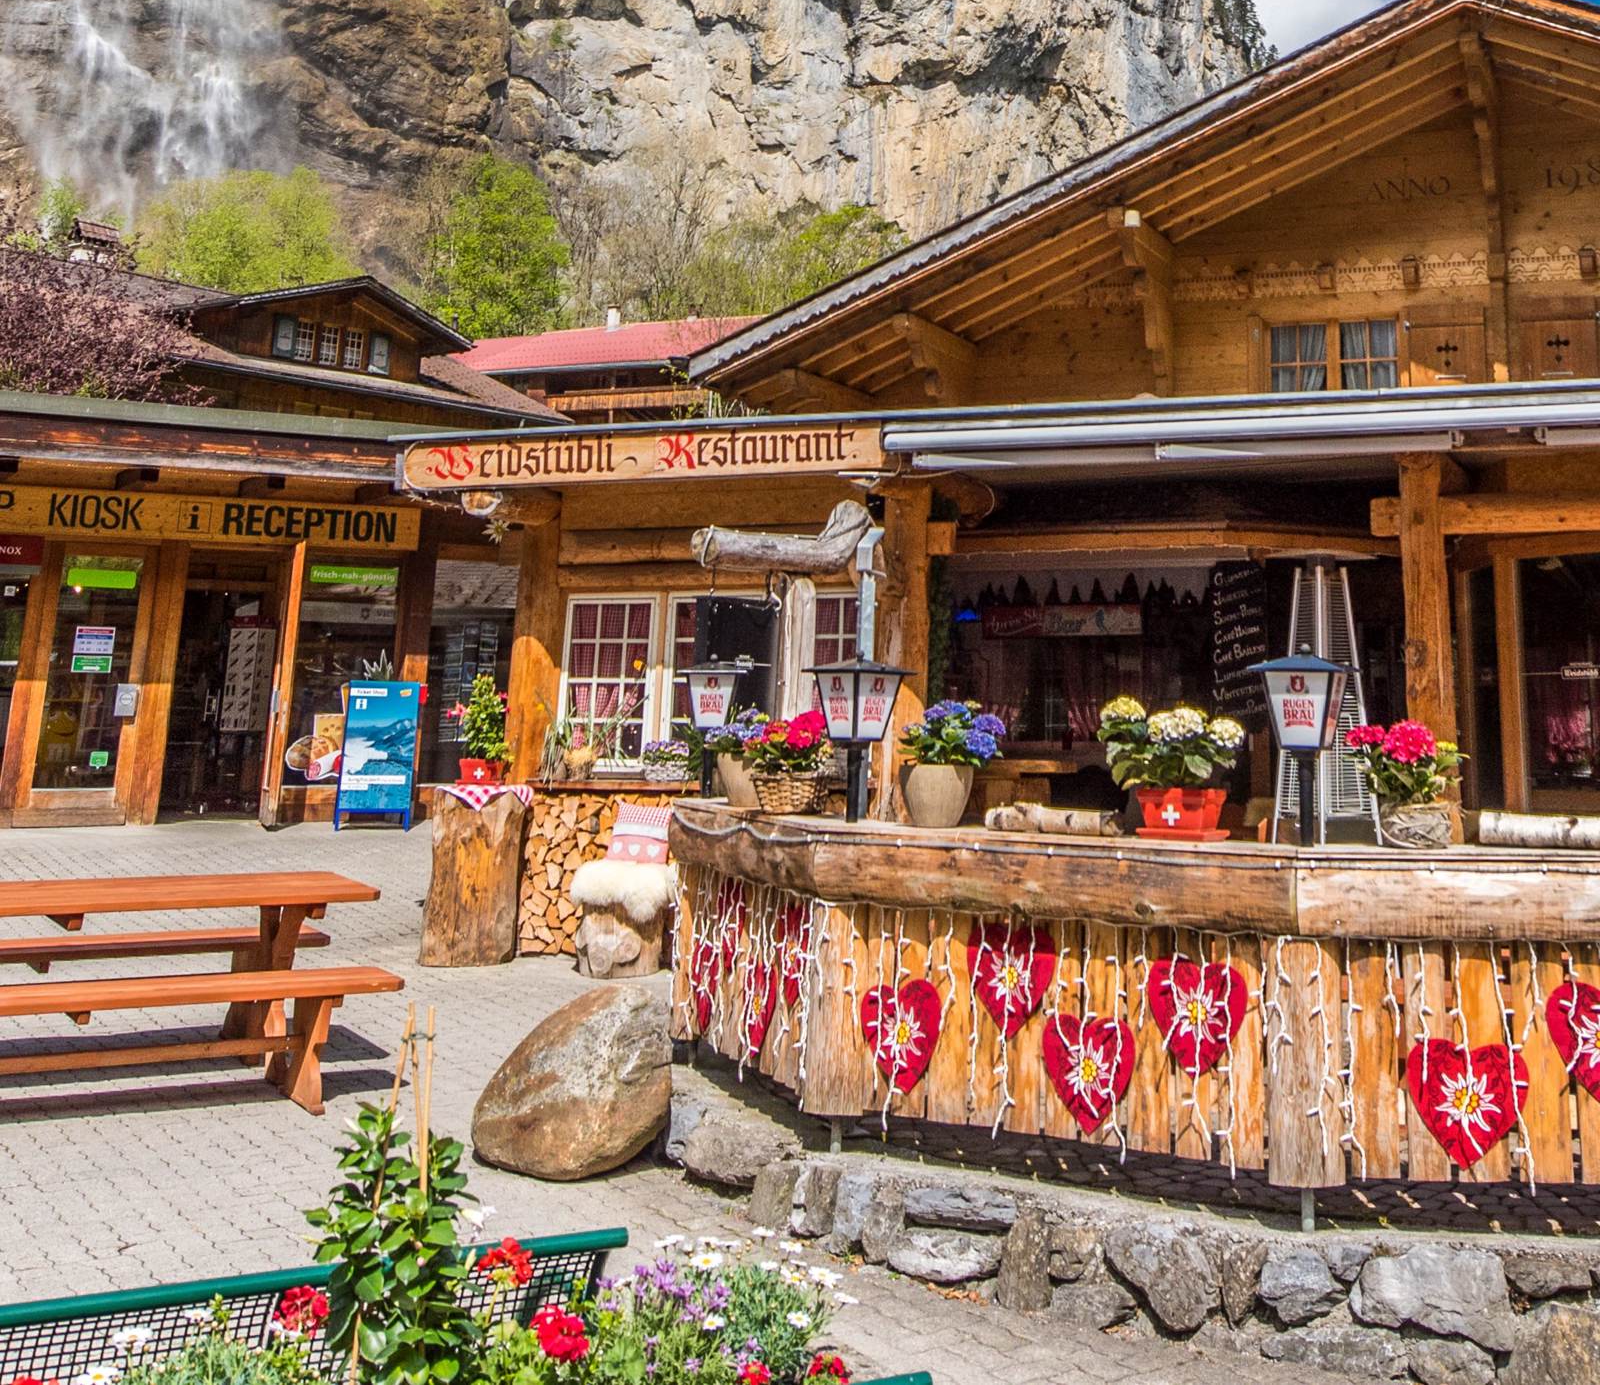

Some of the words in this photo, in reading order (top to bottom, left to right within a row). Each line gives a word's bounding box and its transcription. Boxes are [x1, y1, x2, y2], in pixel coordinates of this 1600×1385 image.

[1369, 176, 1450, 202] ANNO
[425, 436, 615, 481] Weidstübli
[48, 493, 144, 531] KIOSK
[222, 503, 397, 542] RECEPTION
[1283, 698, 1314, 708] RUGEN
